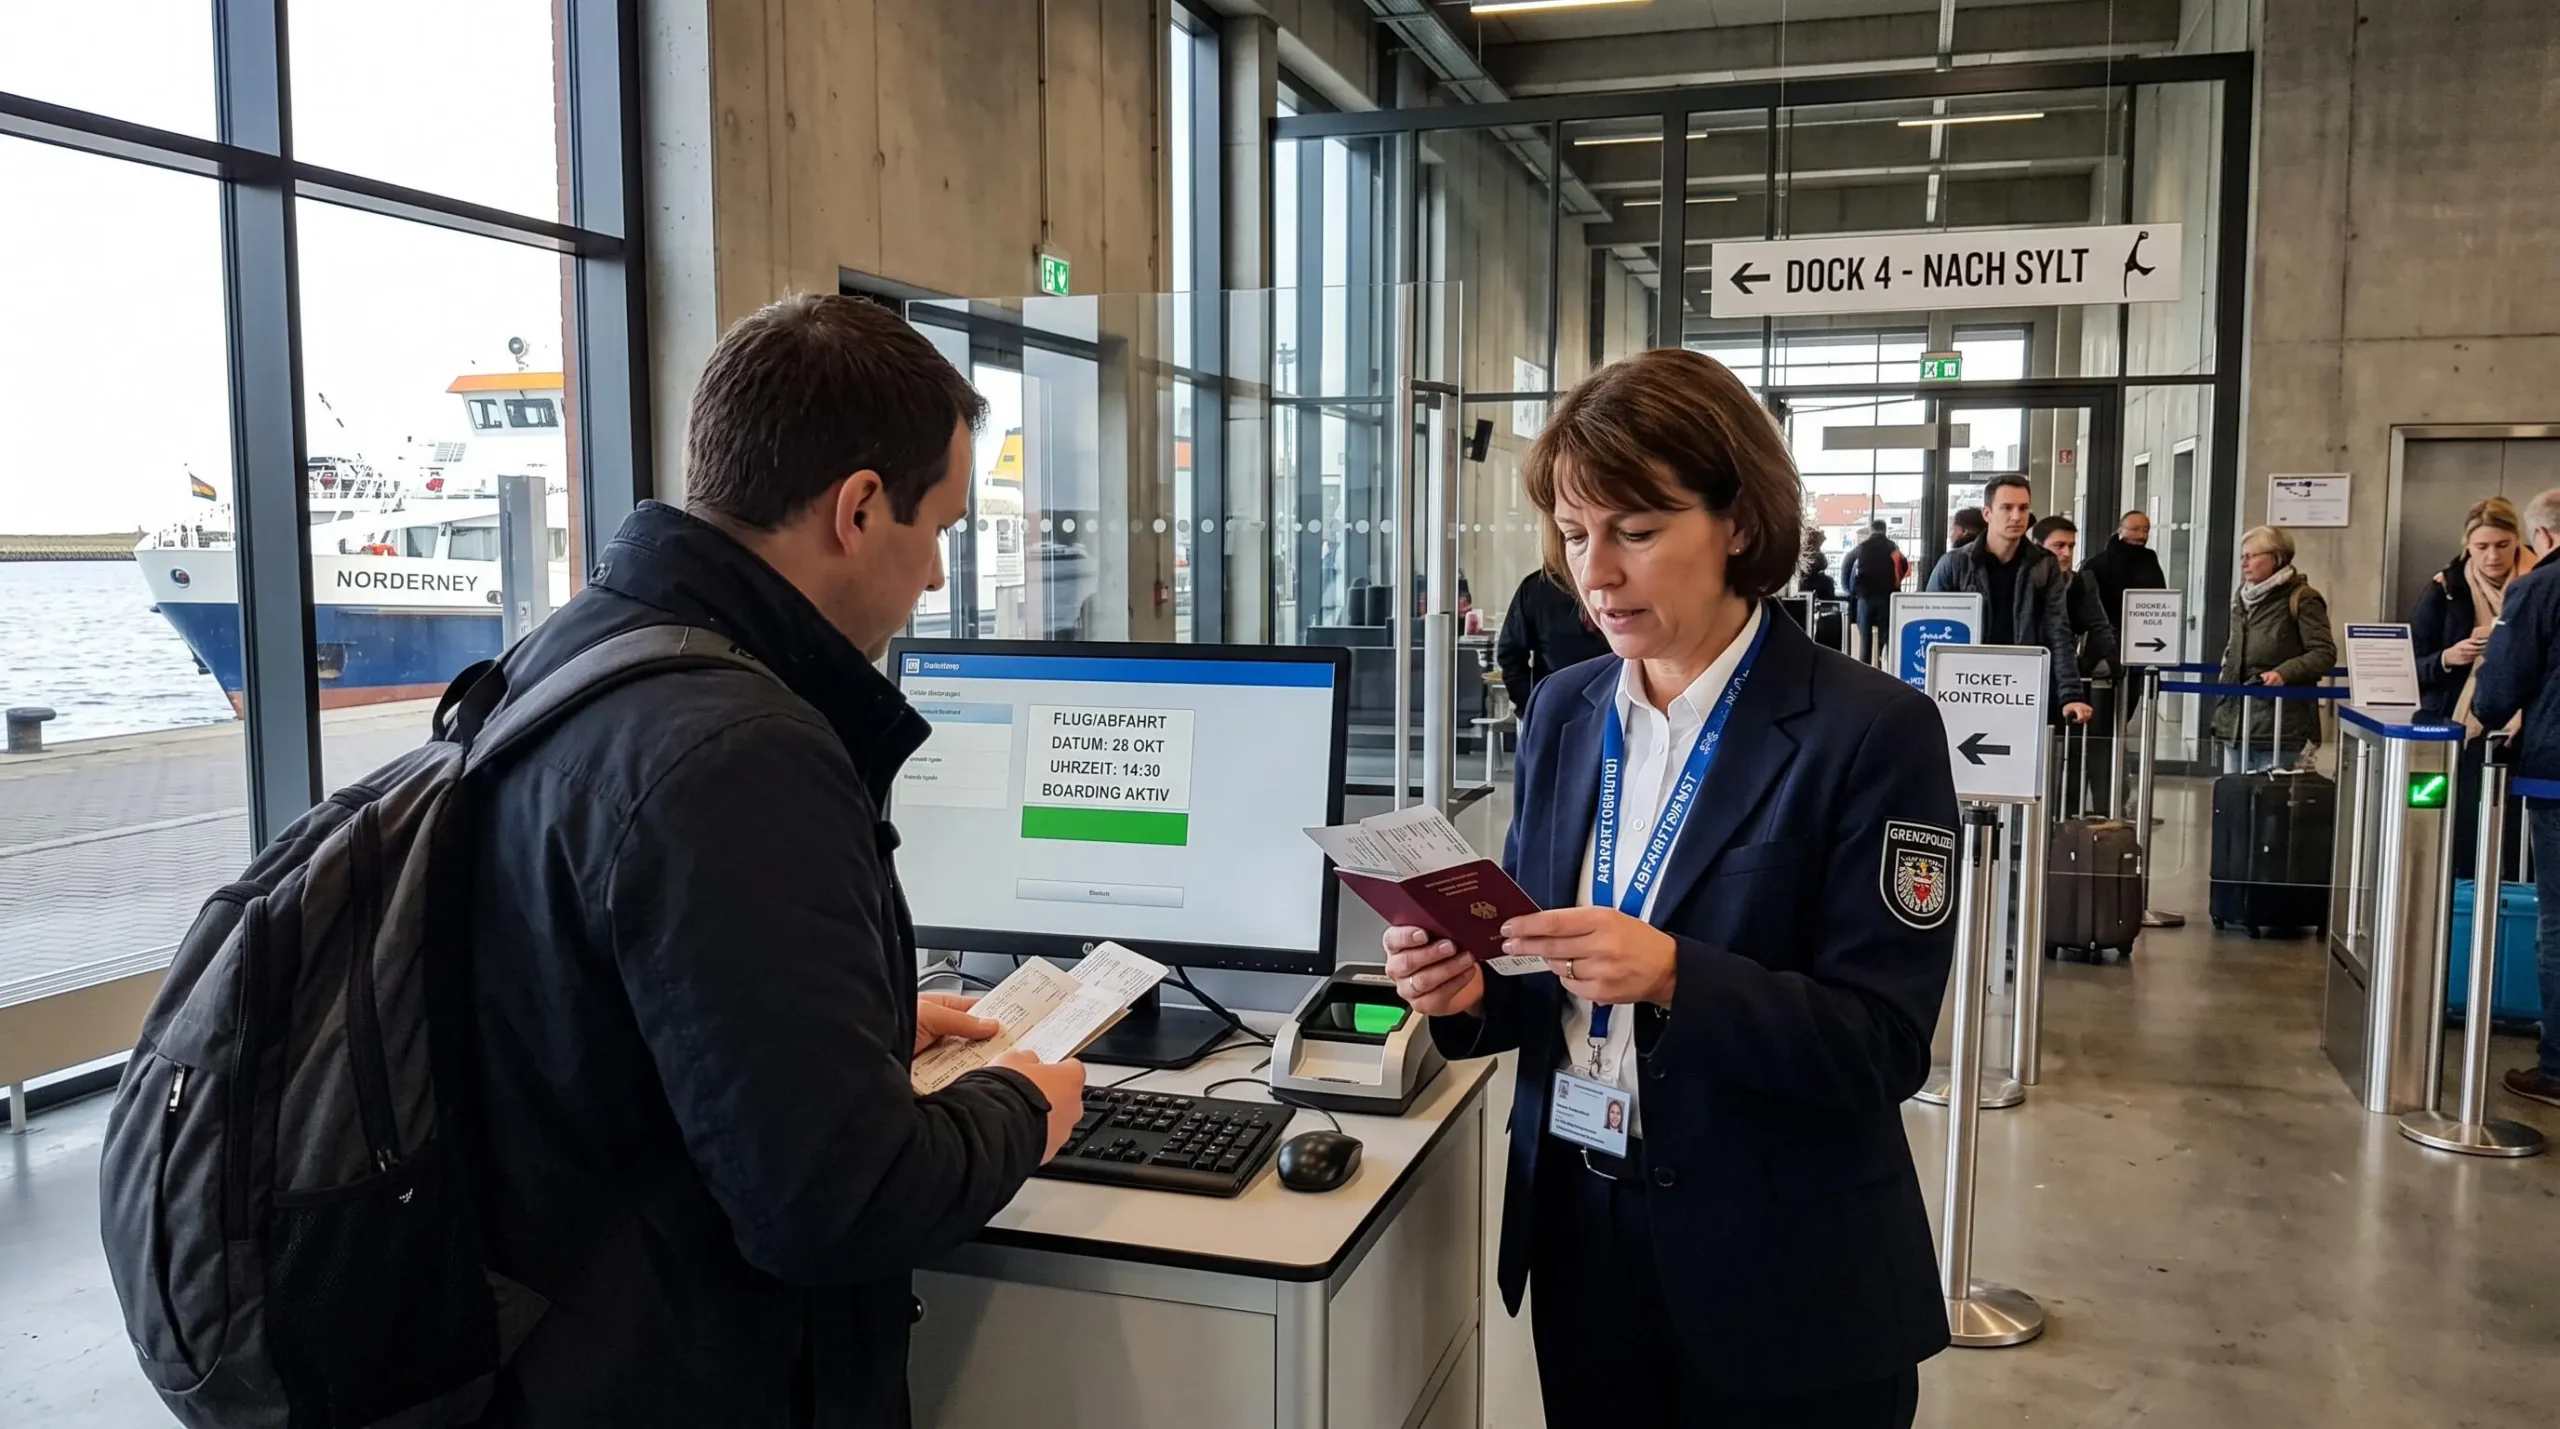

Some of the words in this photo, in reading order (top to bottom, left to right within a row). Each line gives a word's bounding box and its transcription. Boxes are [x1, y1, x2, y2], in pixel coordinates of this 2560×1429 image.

[1786, 256, 1865, 293] DOCK
[1874, 255, 1892, 289] 4
[1923, 251, 2006, 288] NACH
[2014, 248, 2089, 285] SYLT
[336, 570, 478, 592] NORDERNEY
[1955, 672, 2018, 686] TICKET-
[1937, 691, 2035, 706] KONTROLLE
[1053, 712, 1167, 729] FLUG/ABFAHRT
[1052, 736, 1108, 751] DATUM:
[1112, 738, 1129, 752] 28
[1133, 739, 1165, 753] OKT
[1050, 760, 1117, 776] UHRZEIT:
[1122, 763, 1161, 777] 14:30
[1042, 783, 1121, 800] BOARDING
[1125, 787, 1170, 802] AKTIV
